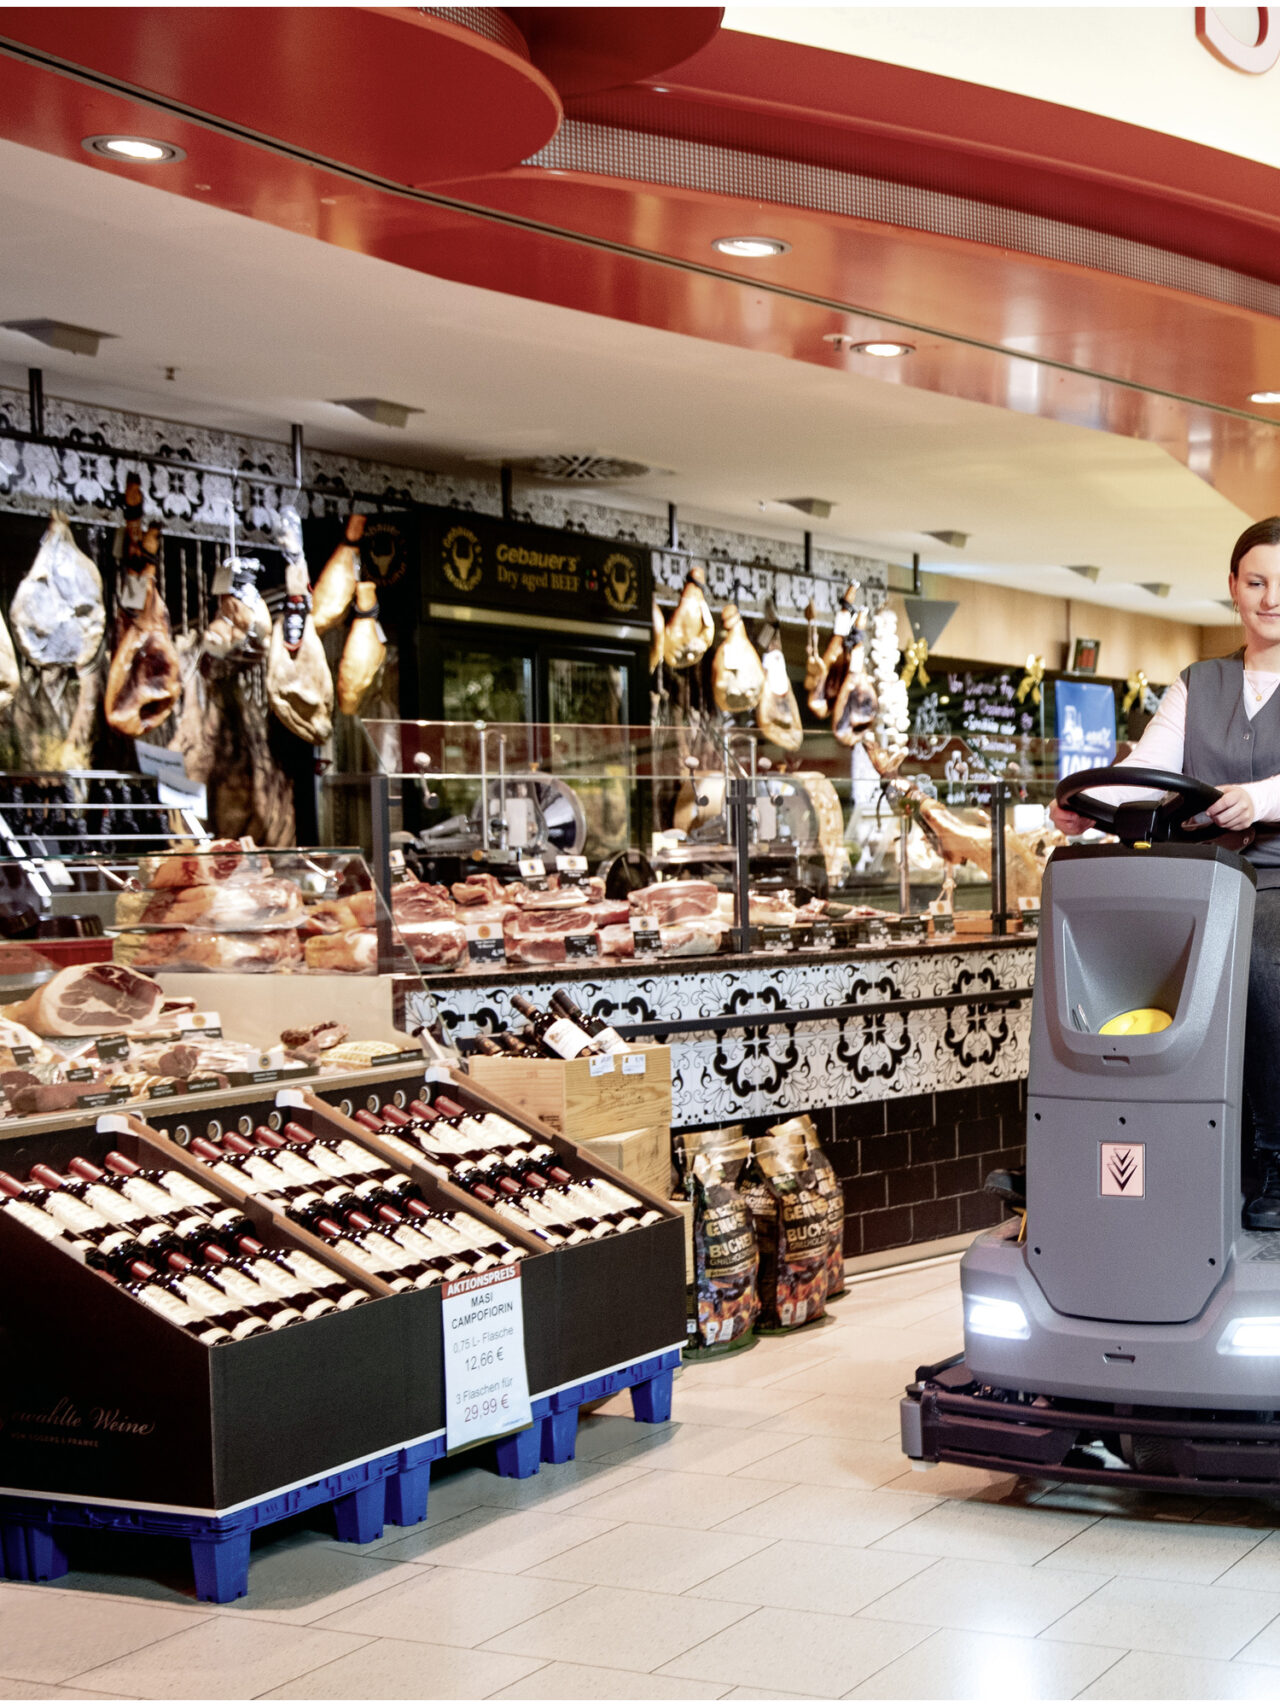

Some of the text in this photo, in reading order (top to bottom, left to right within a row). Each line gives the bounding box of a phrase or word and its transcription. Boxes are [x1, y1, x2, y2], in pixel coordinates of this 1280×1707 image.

[496, 543, 577, 573] Gebauer's
[496, 564, 580, 593] Dry aged BEEF
[447, 1265, 516, 1296] AKTIONSPREIS
[471, 1292, 493, 1307] MASI
[451, 1301, 513, 1329] CAMPOFIORIN
[482, 1327, 514, 1345] Flasche
[465, 1346, 504, 1371] 12,66 €
[456, 1376, 513, 1405] 3 Flaschen für
[89, 1405, 156, 1436] Weine
[464, 1398, 497, 1423] 29,99
[501, 1393, 510, 1409] €
